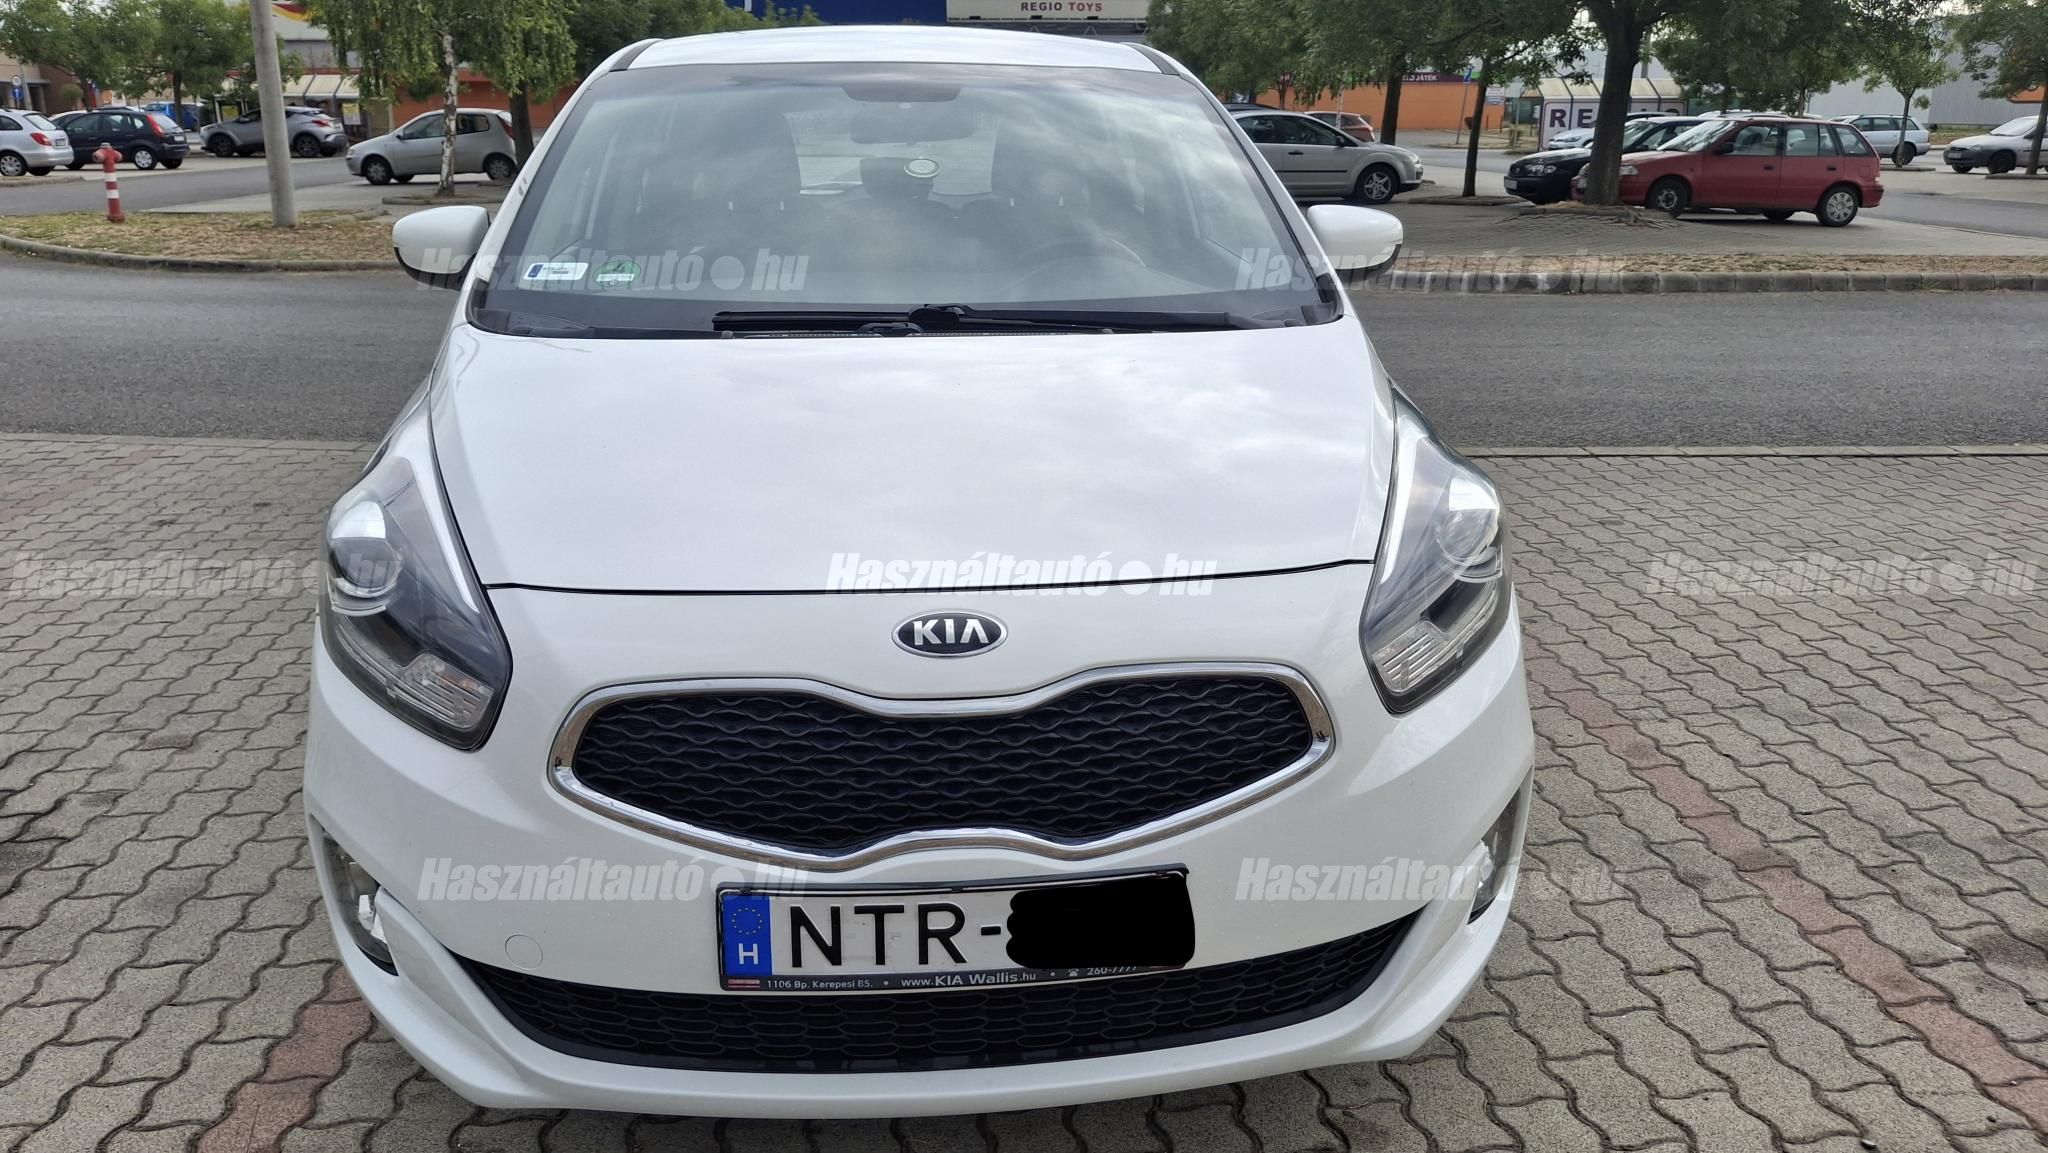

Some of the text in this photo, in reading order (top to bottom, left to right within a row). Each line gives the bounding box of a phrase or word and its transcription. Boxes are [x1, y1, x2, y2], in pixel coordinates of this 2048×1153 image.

[1021, 2, 1103, 12] REGIO TOYS
[912, 618, 990, 646] KIA
[790, 902, 1002, 968] NTR-
[738, 943, 759, 965] H
[767, 980, 791, 989] 1106
[794, 980, 810, 990] Bp.
[812, 979, 855, 989] Kerepesi
[901, 971, 1037, 986] www.KIA Wallis.hu
